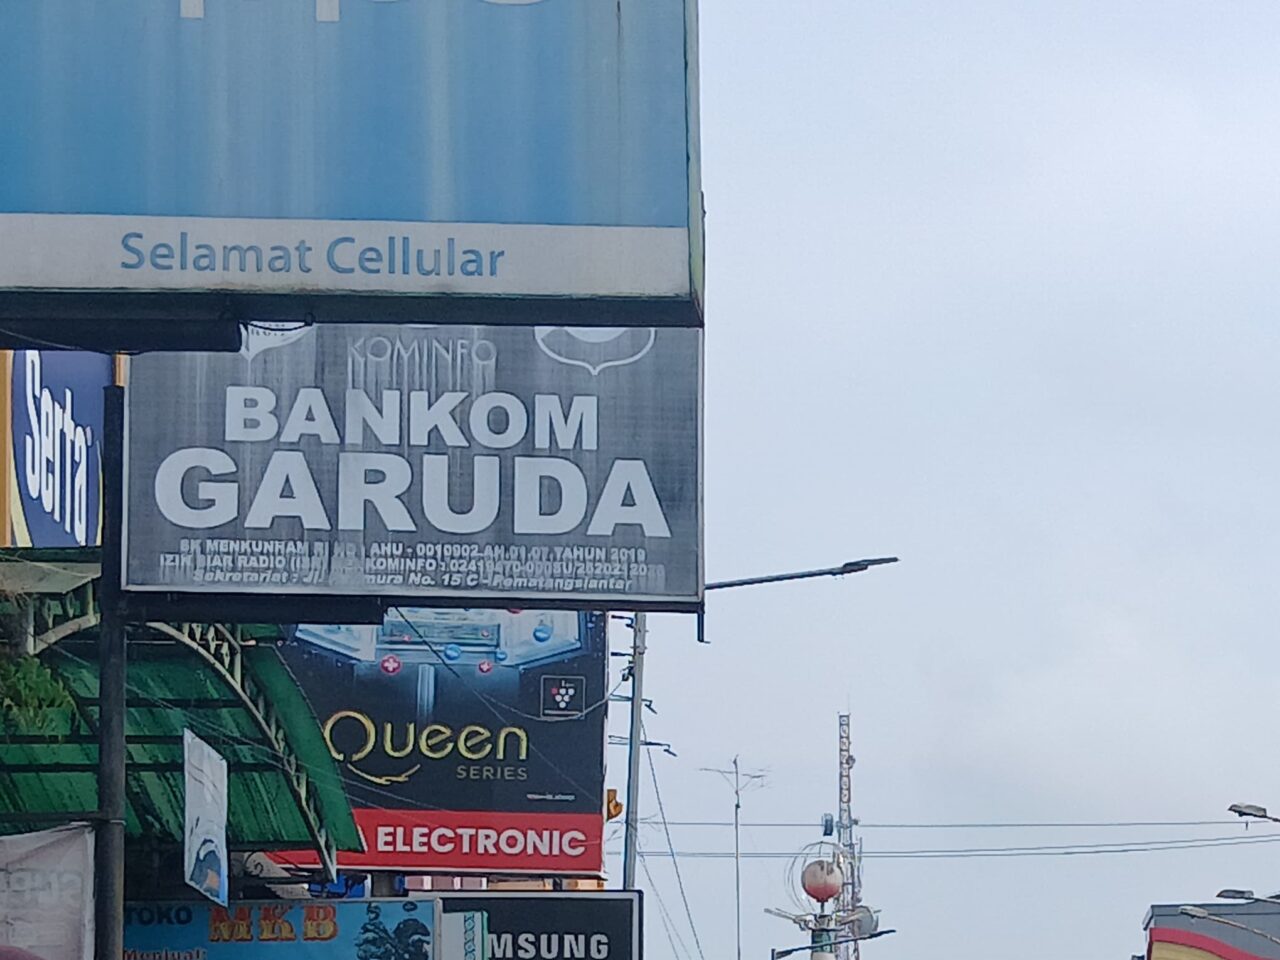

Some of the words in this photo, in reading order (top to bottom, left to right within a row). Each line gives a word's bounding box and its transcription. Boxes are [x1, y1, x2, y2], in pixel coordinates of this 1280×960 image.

[121, 232, 311, 273] Selamat
[326, 236, 505, 277] Cellular
[349, 336, 497, 365] KOMINFO
[224, 385, 598, 450] BANKOM
[153, 447, 672, 538] GARUDA
[238, 555, 286, 568] RADIO
[366, 557, 436, 571] KOMINFO
[370, 542, 403, 556] AHU
[441, 574, 461, 586] 15
[323, 710, 528, 783] Queen
[456, 764, 528, 781] SERIES
[377, 826, 587, 857] ELECTRONIC
